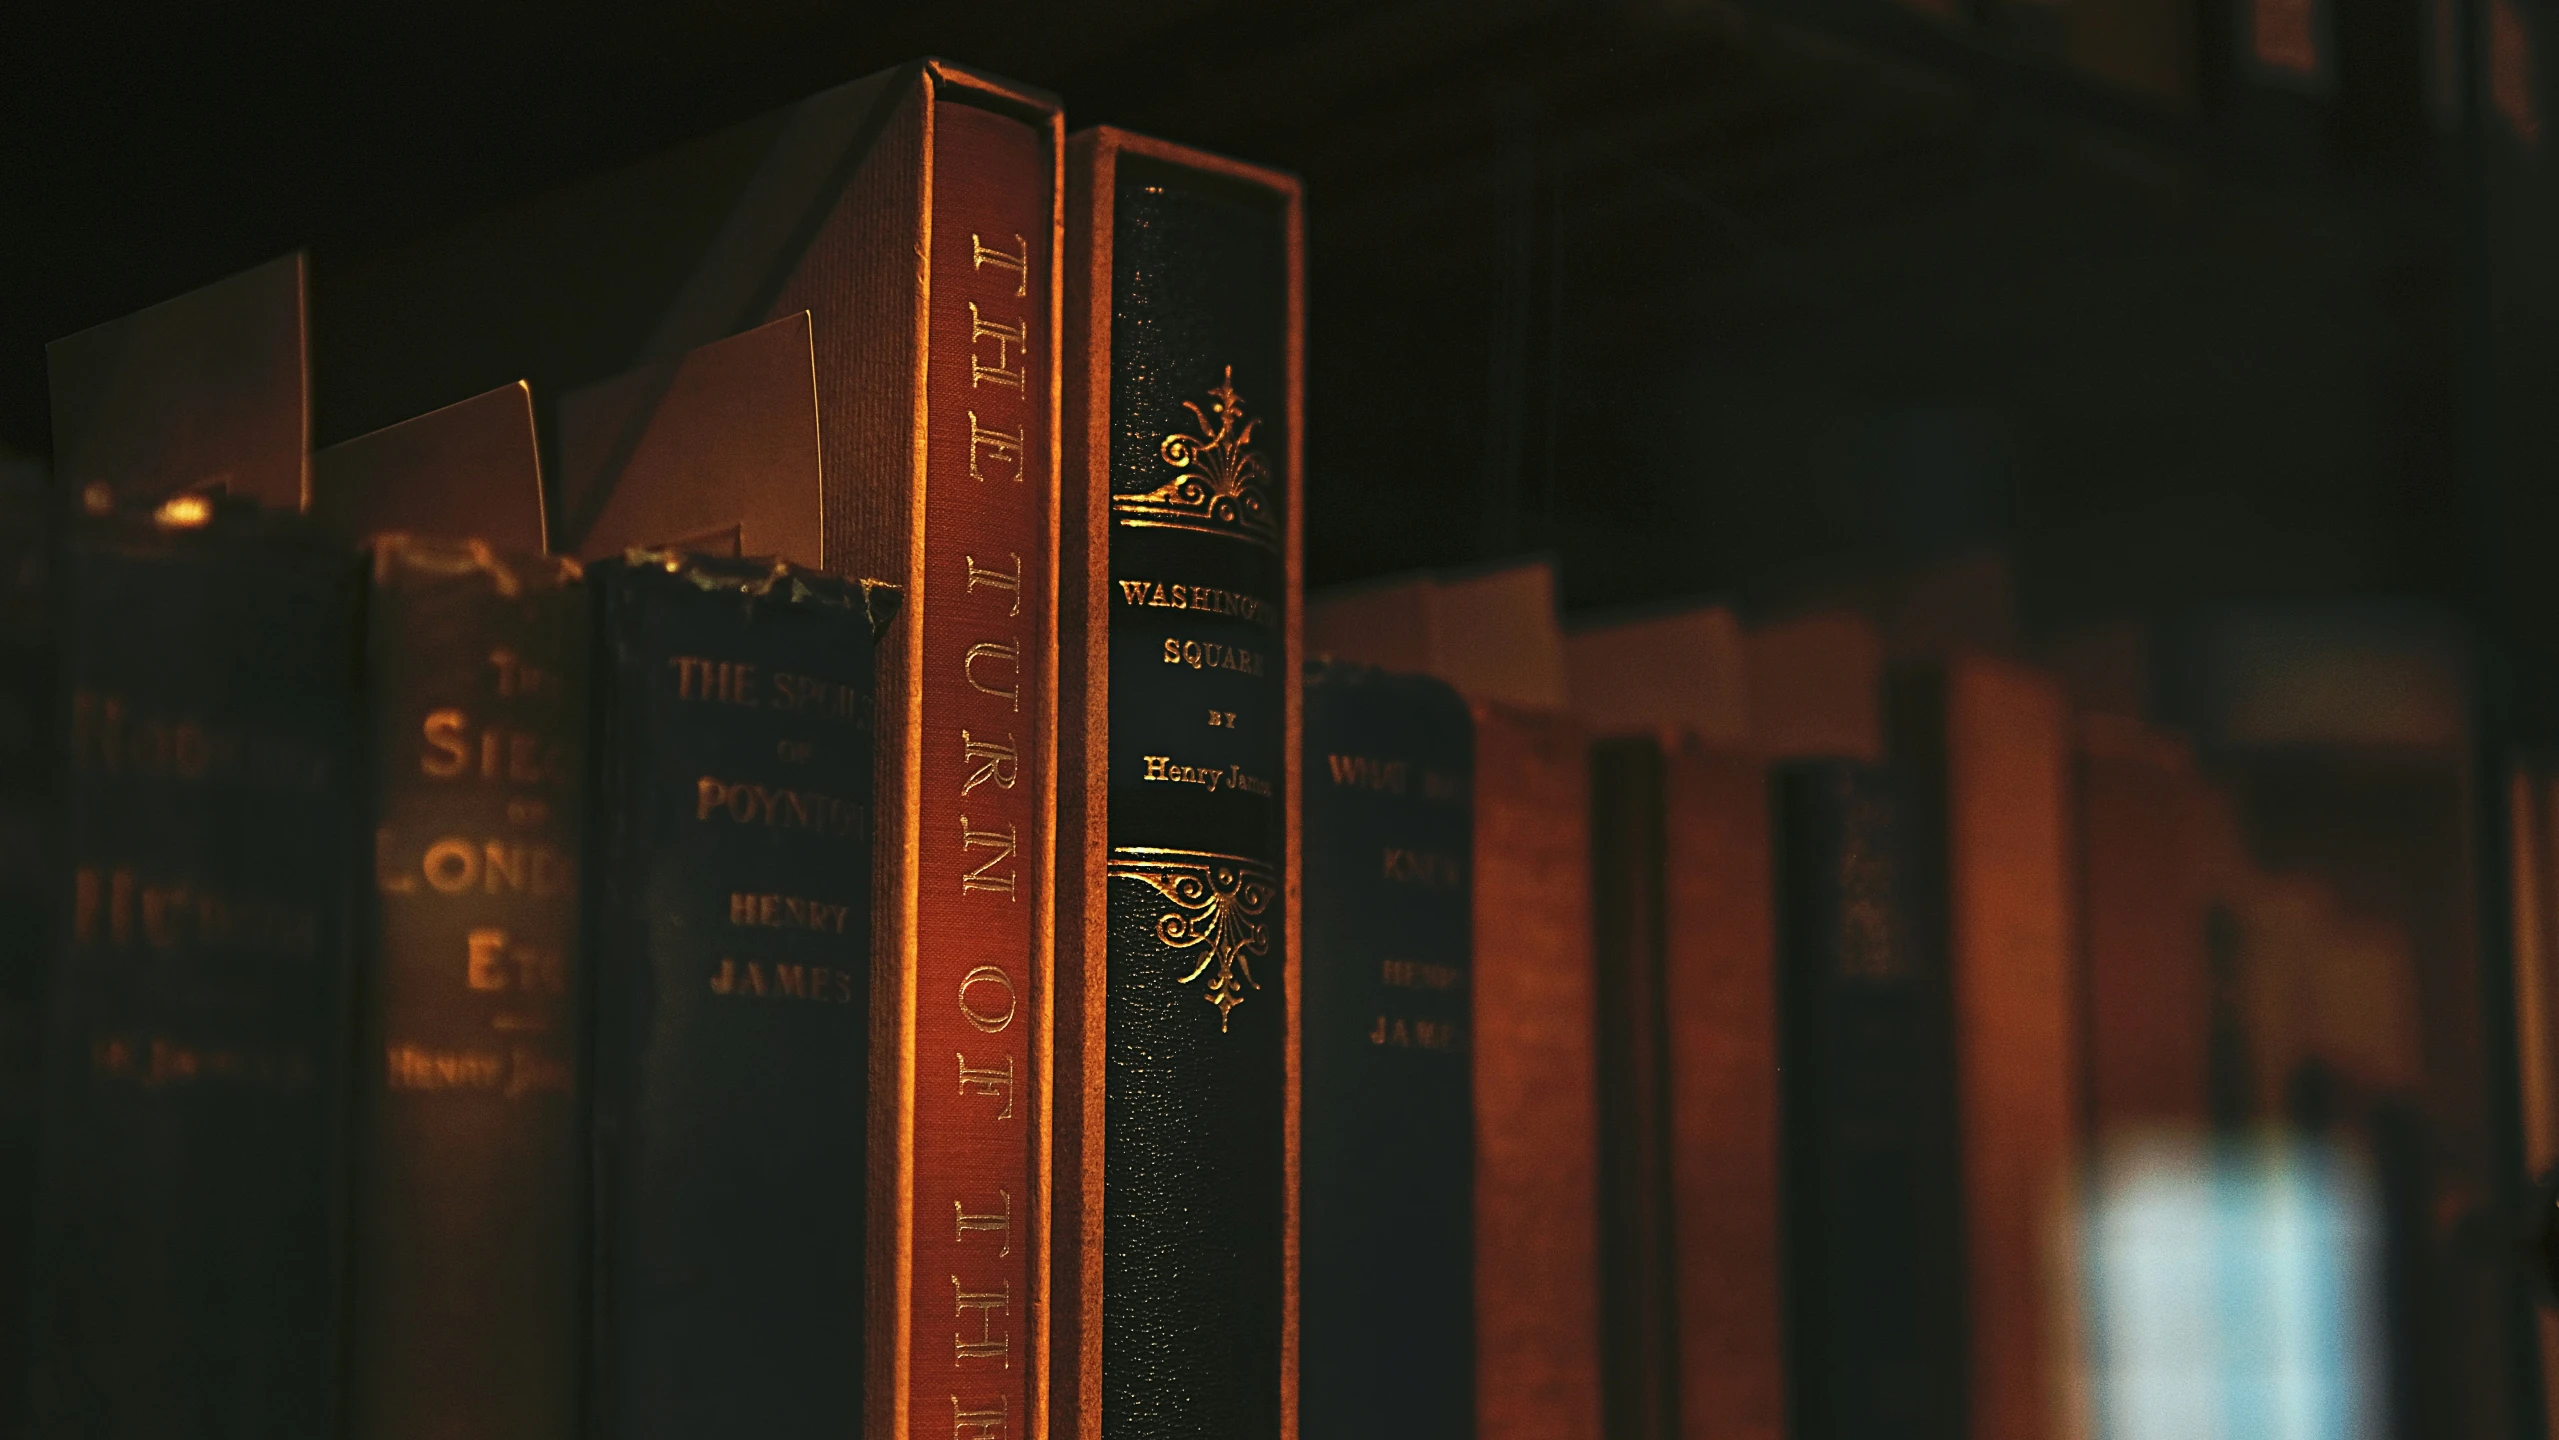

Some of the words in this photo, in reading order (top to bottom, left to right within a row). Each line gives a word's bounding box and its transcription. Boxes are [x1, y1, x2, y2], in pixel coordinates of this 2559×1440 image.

[968, 232, 1028, 483] THE
[668, 655, 760, 708] THE
[1162, 637, 1265, 678] SQUARE
[959, 553, 1021, 903] TURN
[1208, 709, 1237, 729] BY
[1143, 755, 1224, 793] Henry
[728, 890, 851, 935] HENRY
[710, 955, 853, 1005] JAMES
[957, 964, 1016, 1120] OF
